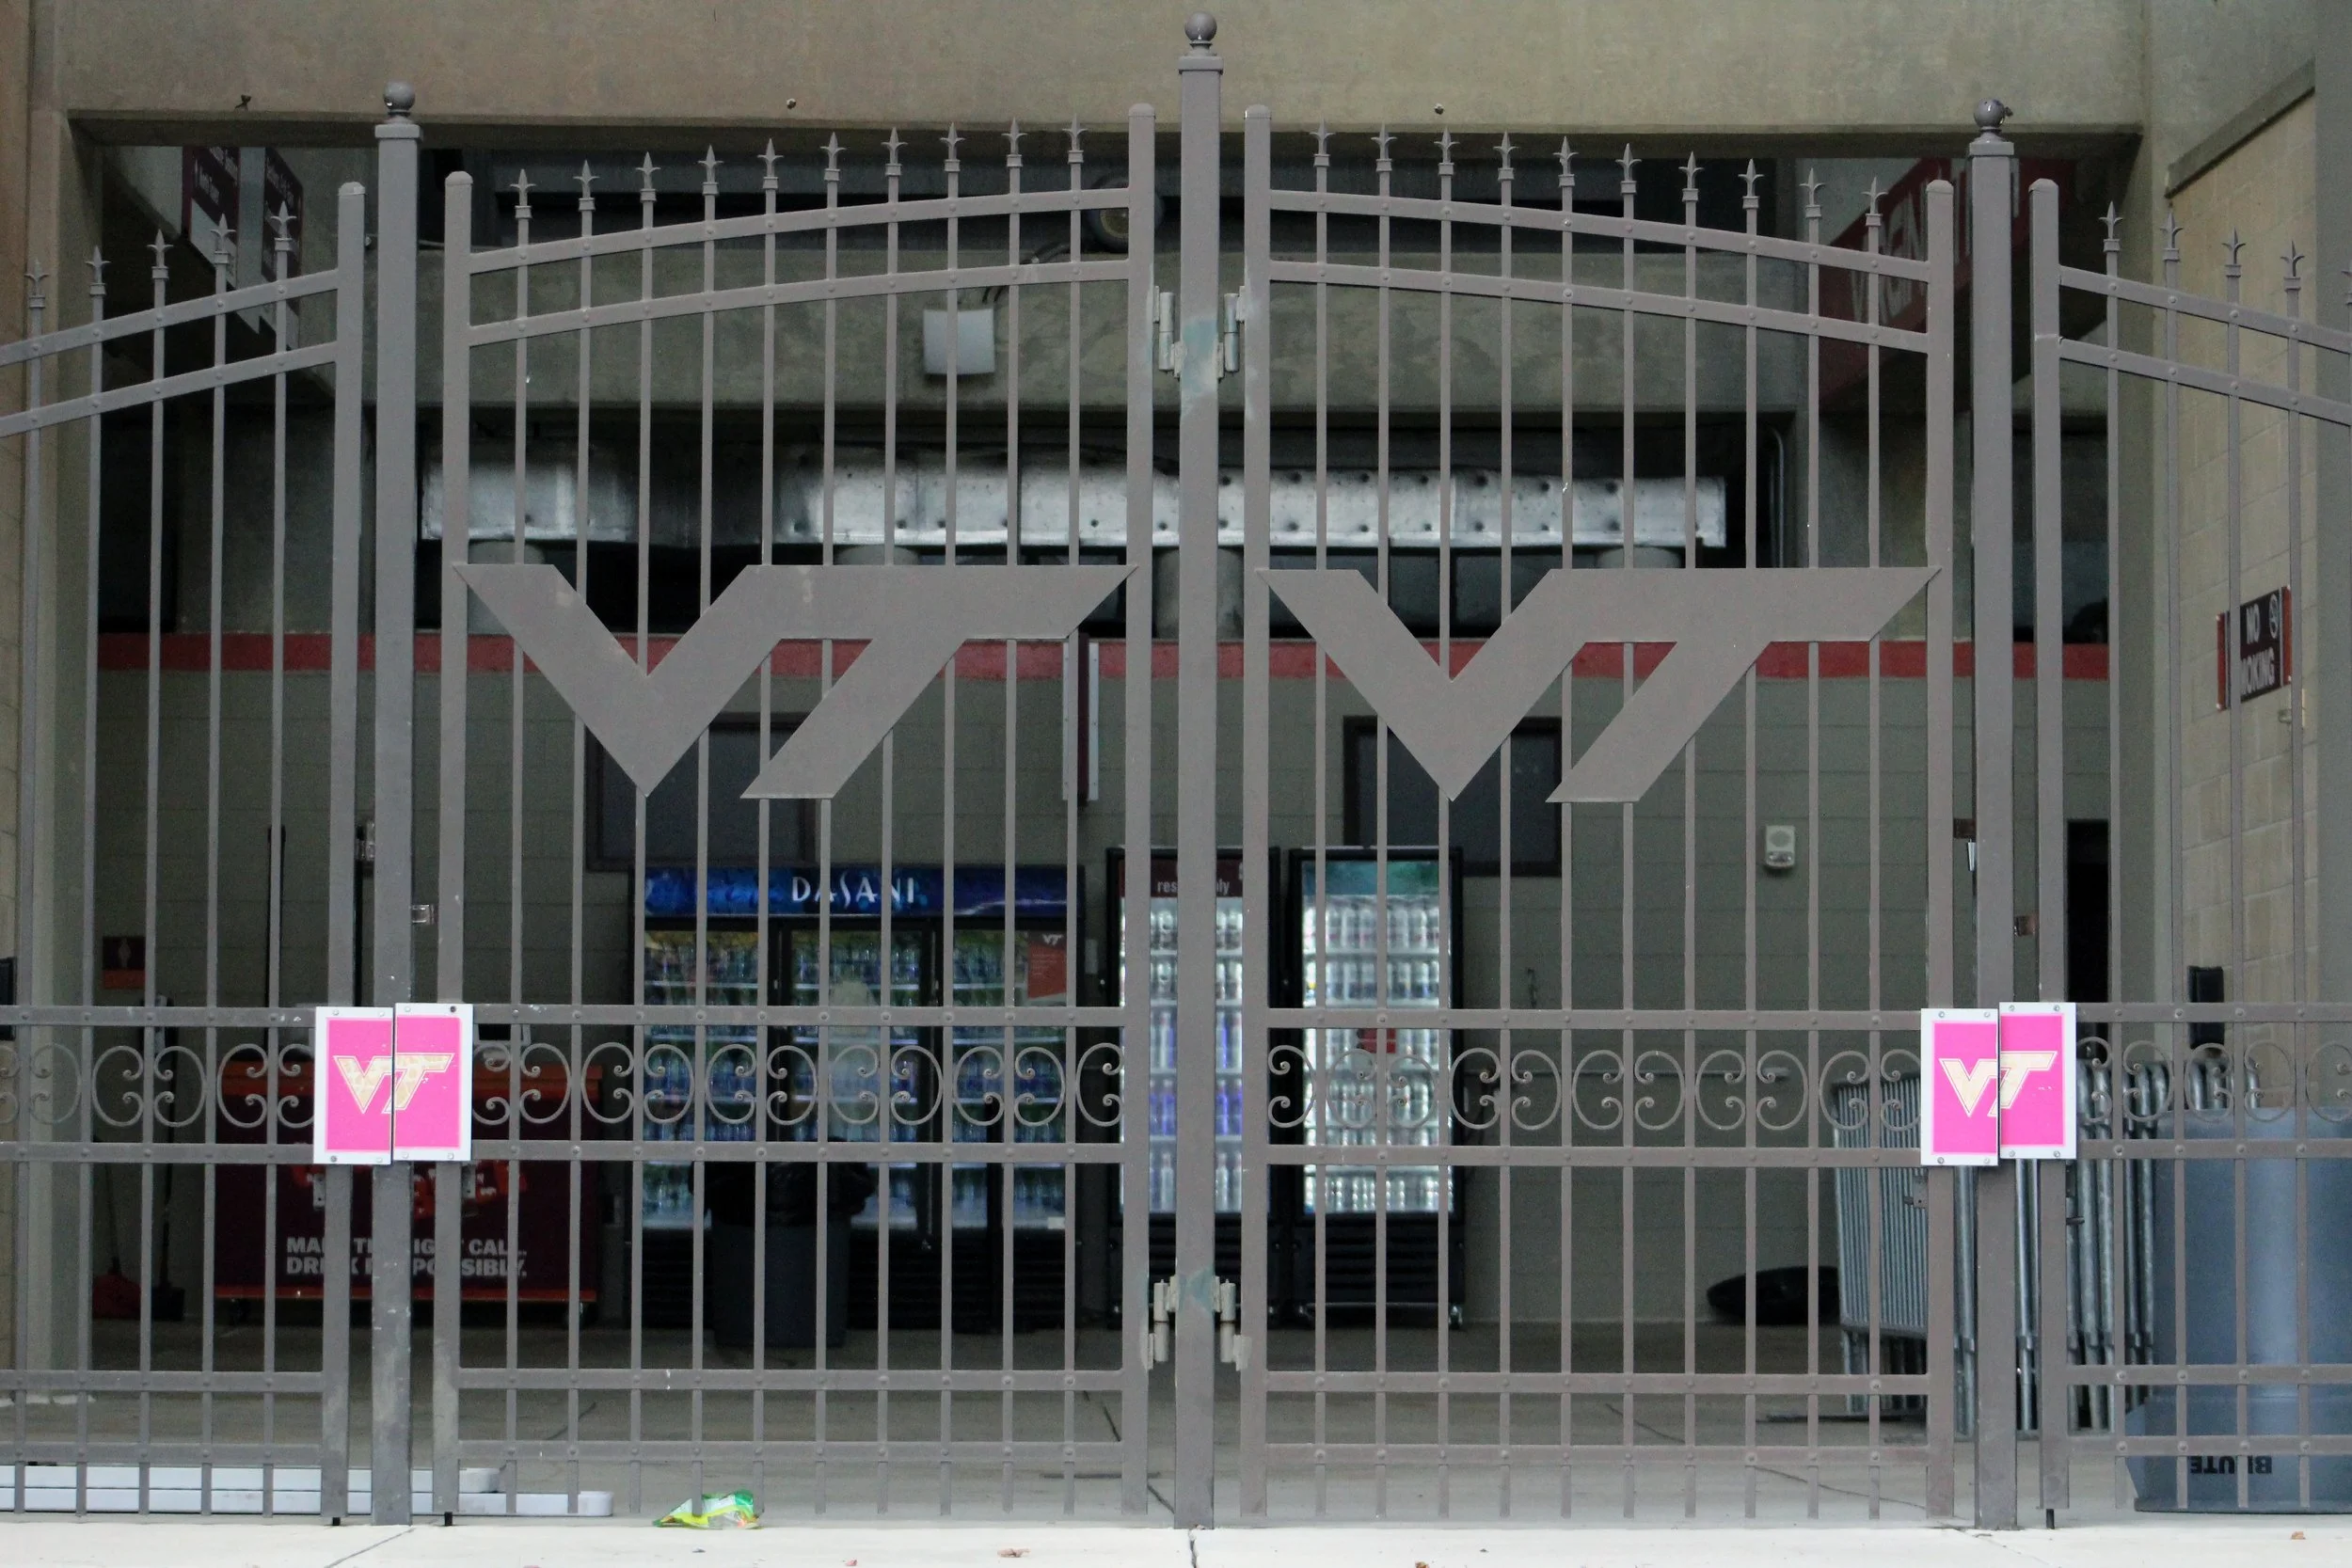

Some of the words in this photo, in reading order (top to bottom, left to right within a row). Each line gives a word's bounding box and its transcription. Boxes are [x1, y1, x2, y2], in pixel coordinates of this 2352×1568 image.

[2246, 603, 2261, 644] NO
[452, 564, 1139, 799] VT
[1254, 568, 1942, 802] VT
[2234, 646, 2275, 696] MOKING
[333, 1053, 455, 1115] VT
[1938, 1051, 2058, 1118] VT
[286, 1257, 360, 1275] DRIK
[469, 1239, 528, 1257] CAL.
